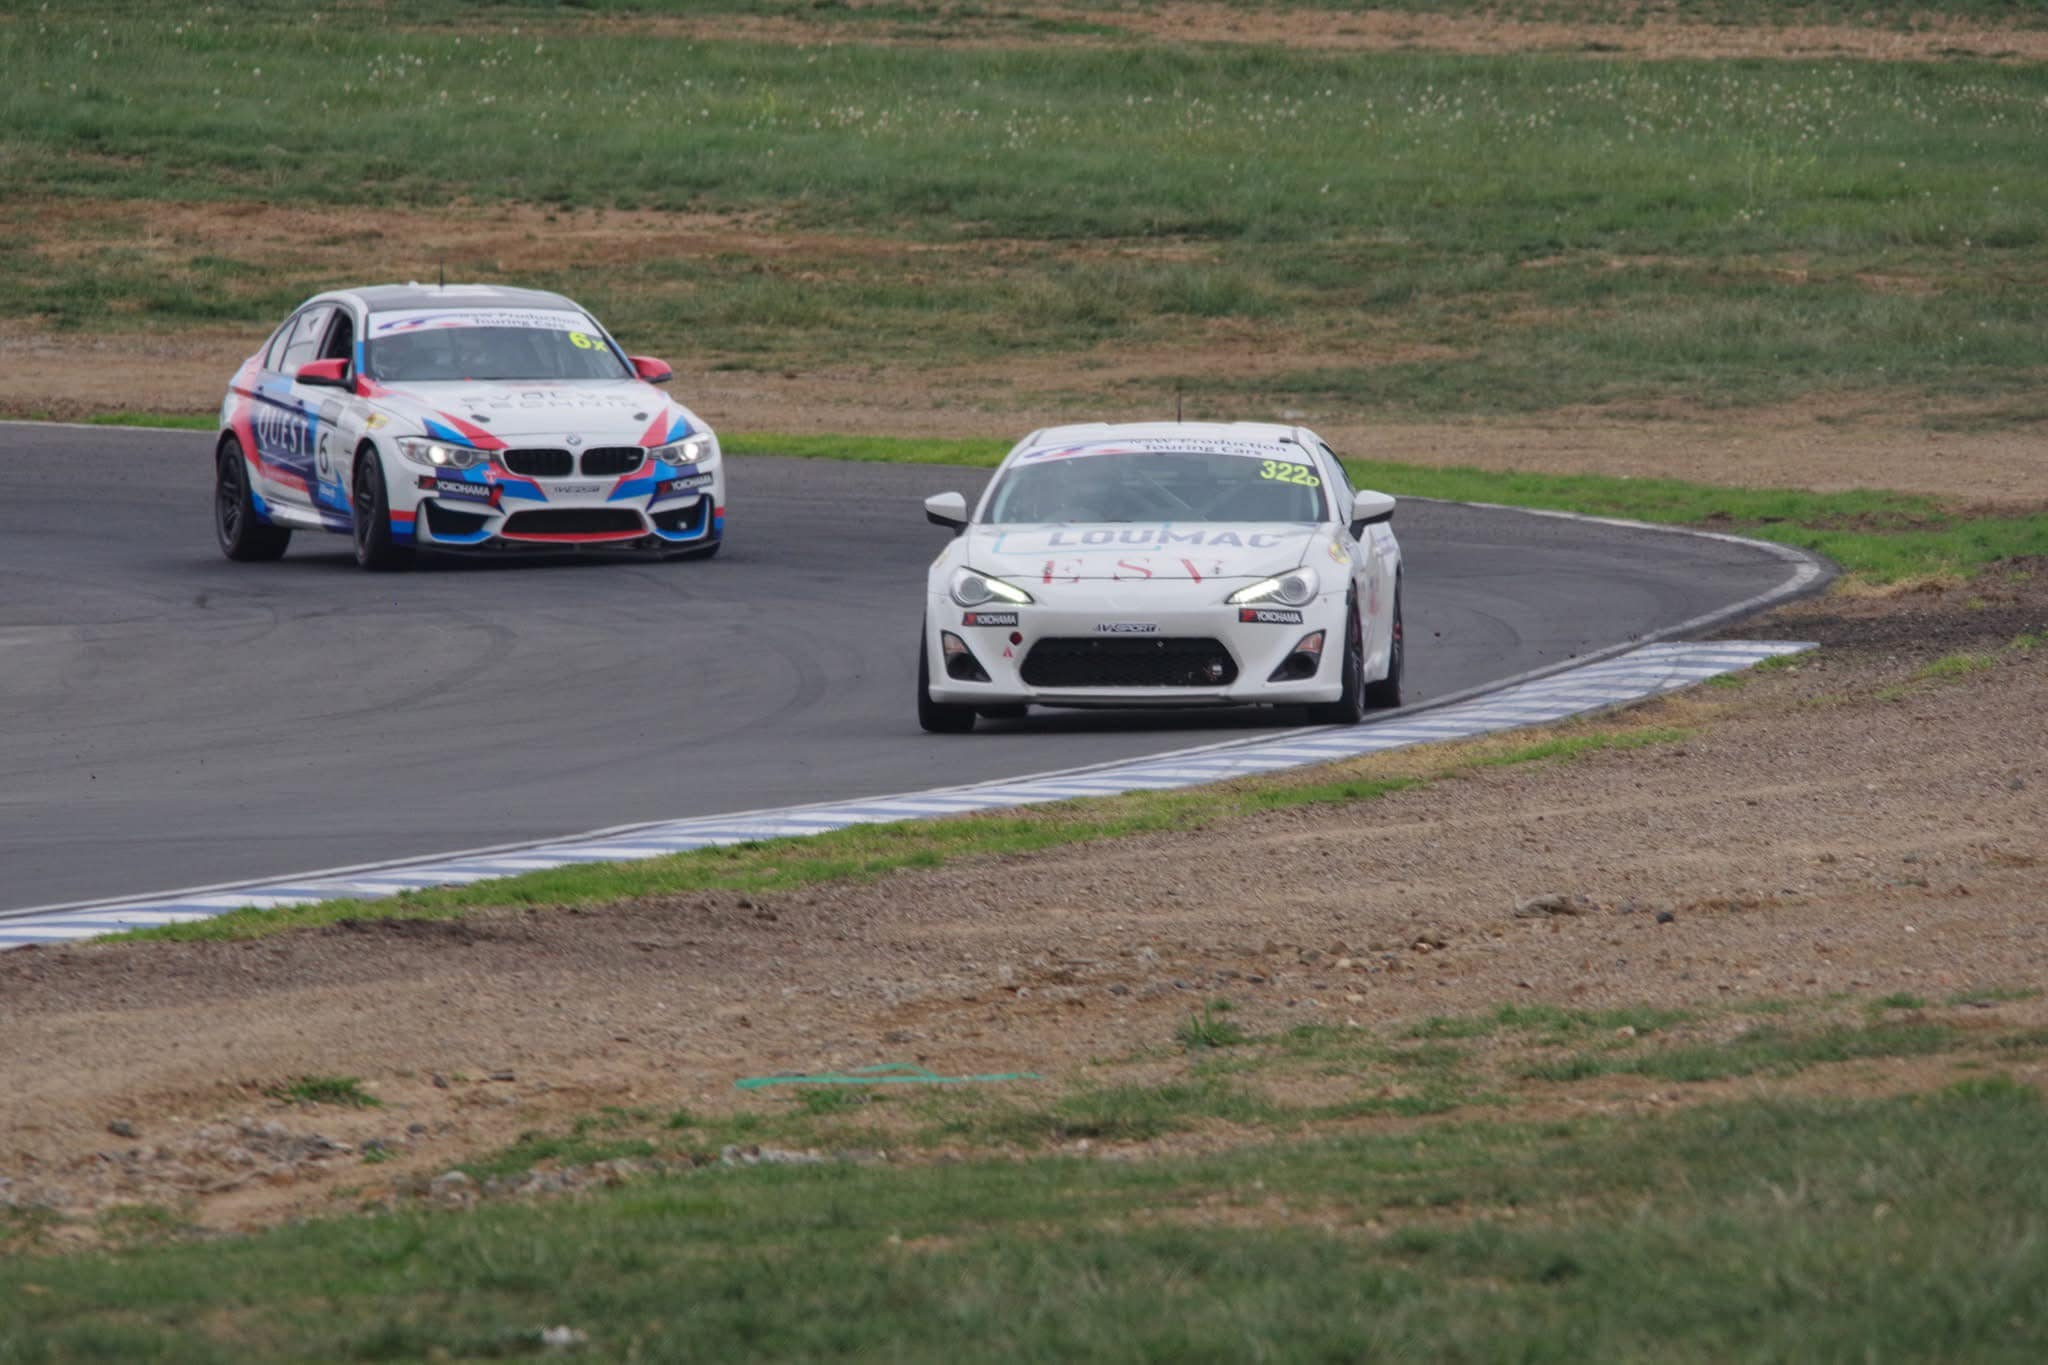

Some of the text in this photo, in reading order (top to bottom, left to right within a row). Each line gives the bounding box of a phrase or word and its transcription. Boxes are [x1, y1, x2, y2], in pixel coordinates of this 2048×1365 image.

[257, 406, 309, 457] QUEST
[318, 432, 329, 476] 6
[1145, 443, 1263, 456] Touring Cars
[1179, 438, 1288, 453] Production
[436, 479, 490, 497] YOKOHAMA
[671, 473, 713, 490] YOKOHAMA
[1047, 528, 1283, 549] LOUMAC
[976, 614, 1018, 626] YOKOHAMA
[1256, 611, 1302, 623] YOKOHAMA
